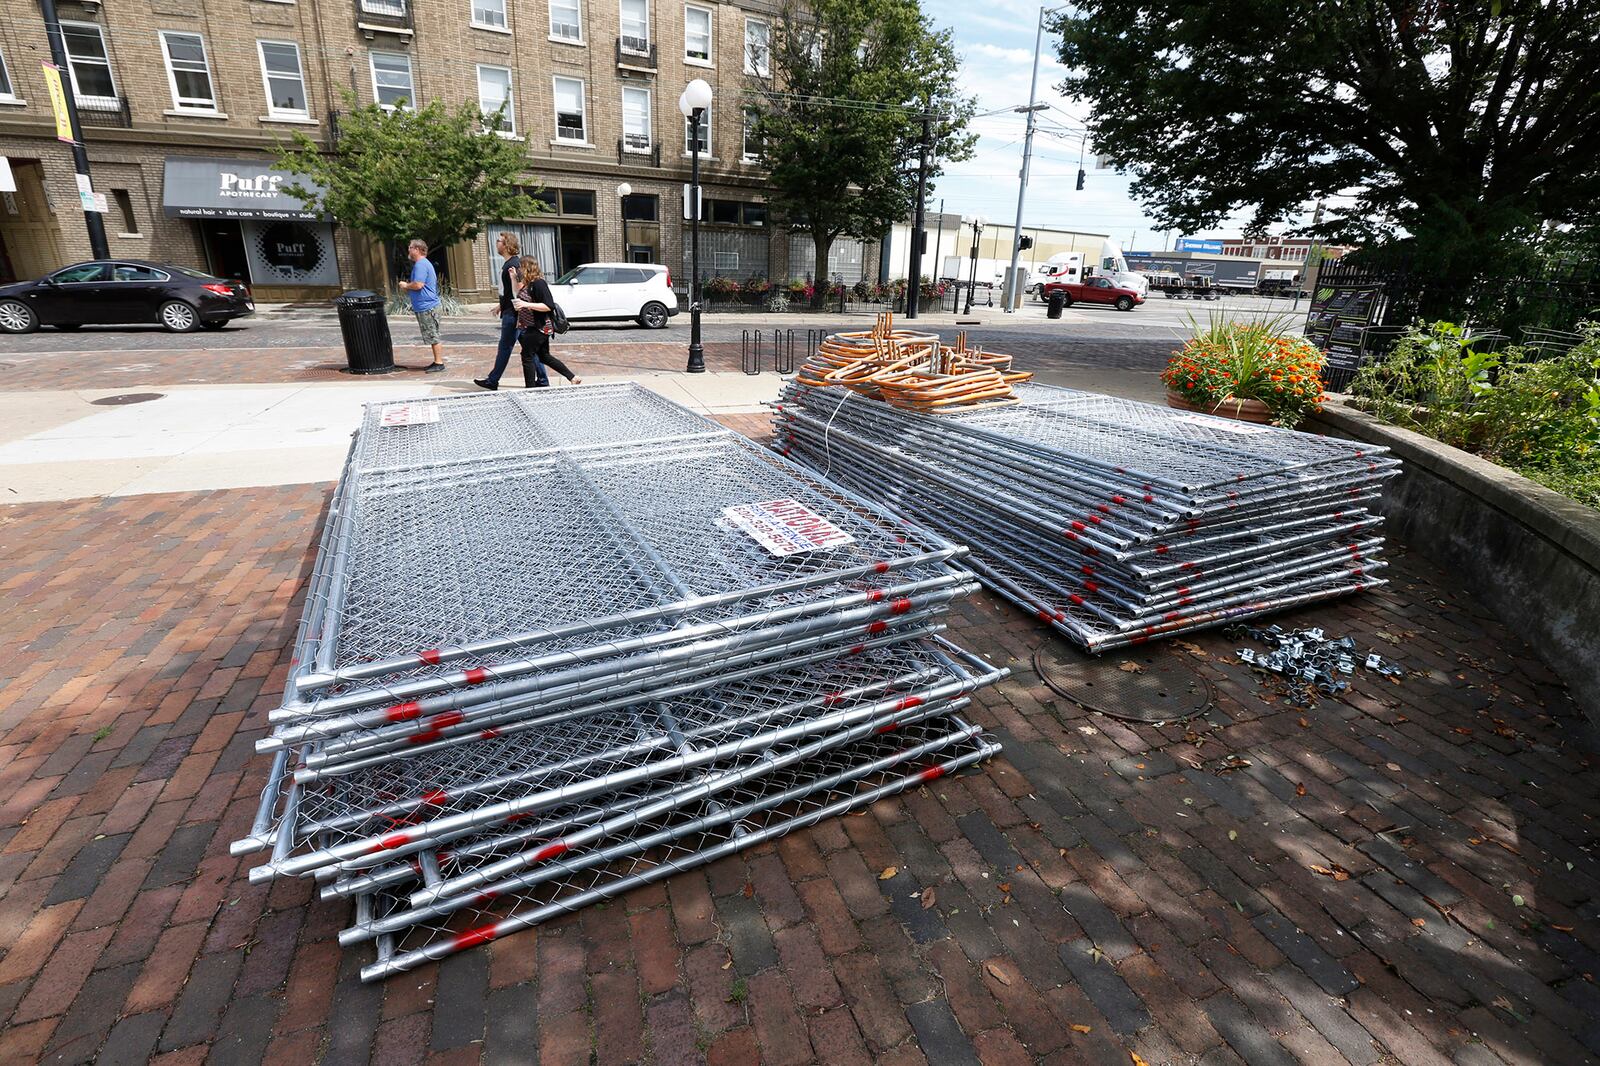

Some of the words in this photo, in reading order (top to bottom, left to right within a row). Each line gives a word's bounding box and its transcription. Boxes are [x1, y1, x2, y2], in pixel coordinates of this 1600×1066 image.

[220, 173, 283, 191] Puff
[263, 211, 289, 219] boutique
[277, 243, 305, 253] Puff
[759, 499, 847, 547] NATIONAL
